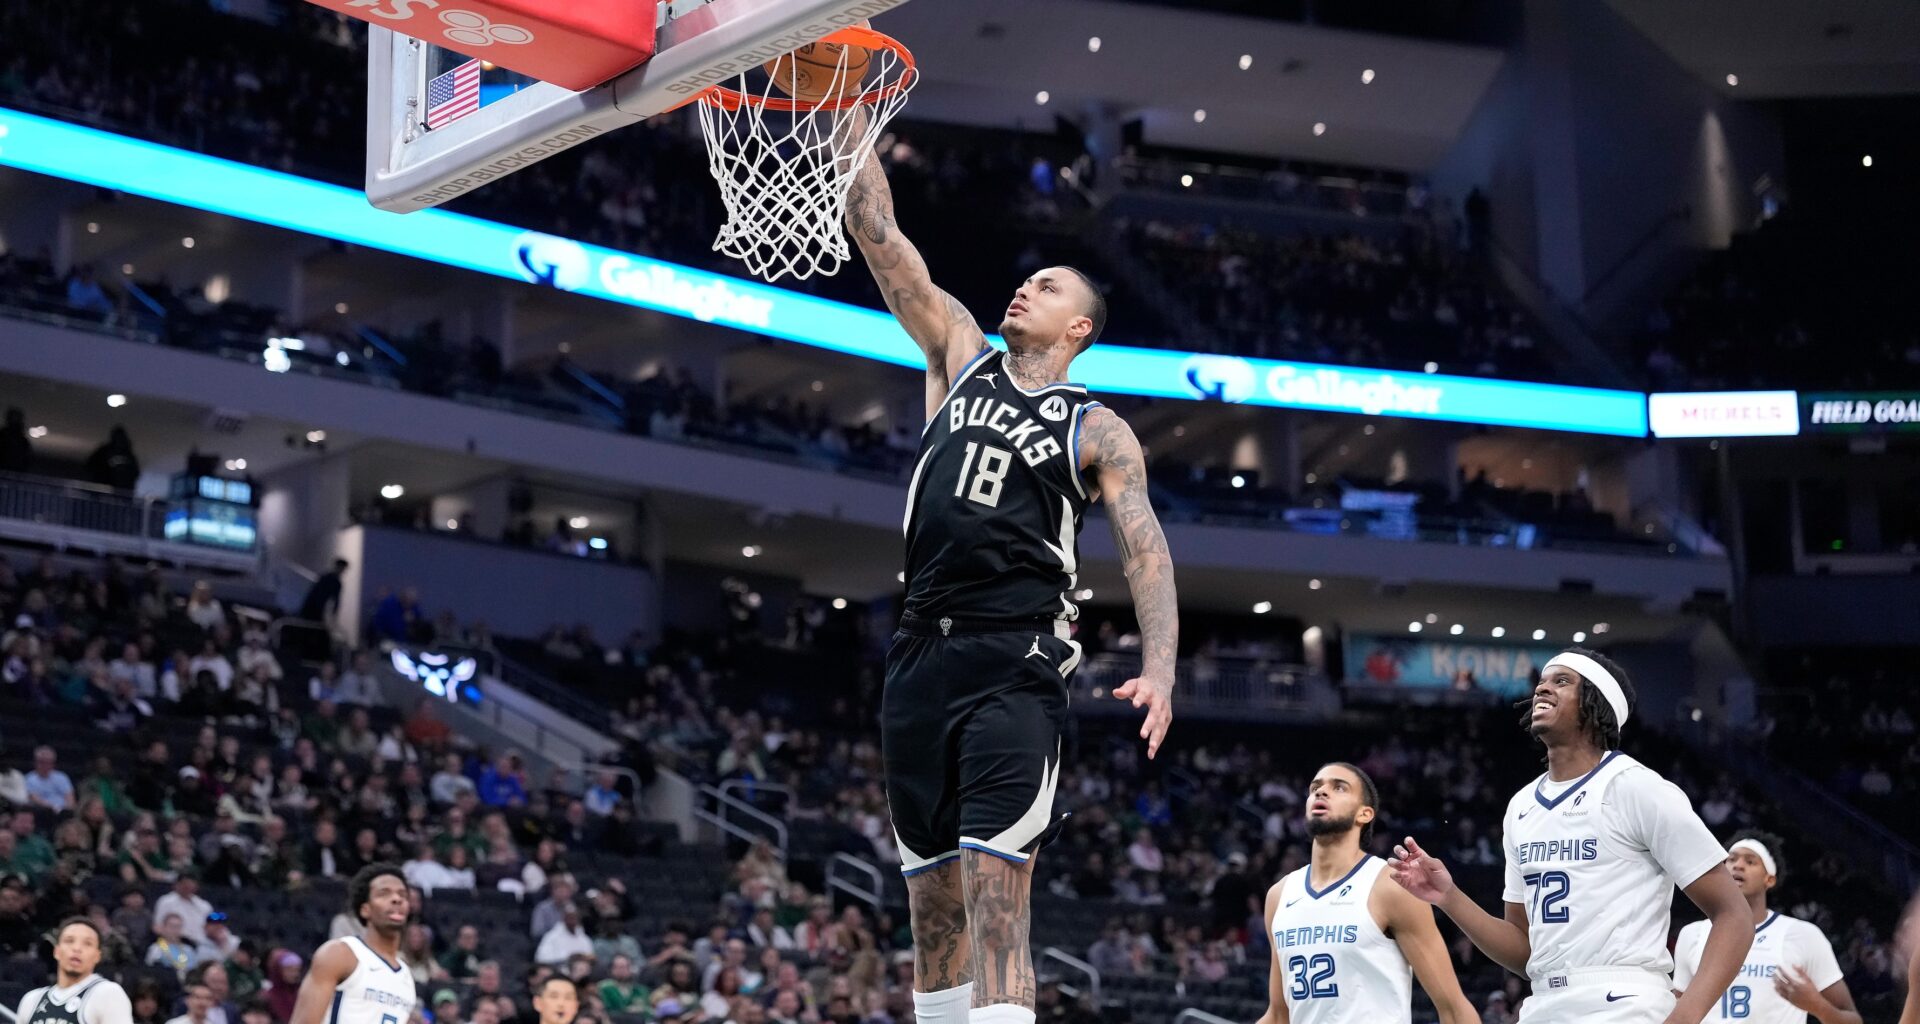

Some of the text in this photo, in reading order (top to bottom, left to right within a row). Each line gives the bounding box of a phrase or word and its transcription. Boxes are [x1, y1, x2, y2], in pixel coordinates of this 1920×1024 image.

[666, 0, 905, 94] SHOP.BUCKS.COM
[412, 124, 602, 204] SHOP.BUCKS.COM
[601, 256, 773, 327] Gallagher
[1266, 365, 1443, 415] Gallagher
[1811, 400, 1920, 423] FIELD GOA
[949, 397, 1062, 467] BUCKS
[954, 441, 1013, 508] 18
[1431, 645, 1532, 680] KONA
[1516, 839, 1598, 865] EMPHIS
[1523, 870, 1570, 926] 72
[1274, 925, 1358, 949] MEMPHIS
[1288, 953, 1339, 1001] 32
[1740, 964, 1777, 978] PHIS
[1722, 985, 1751, 1019] 18
